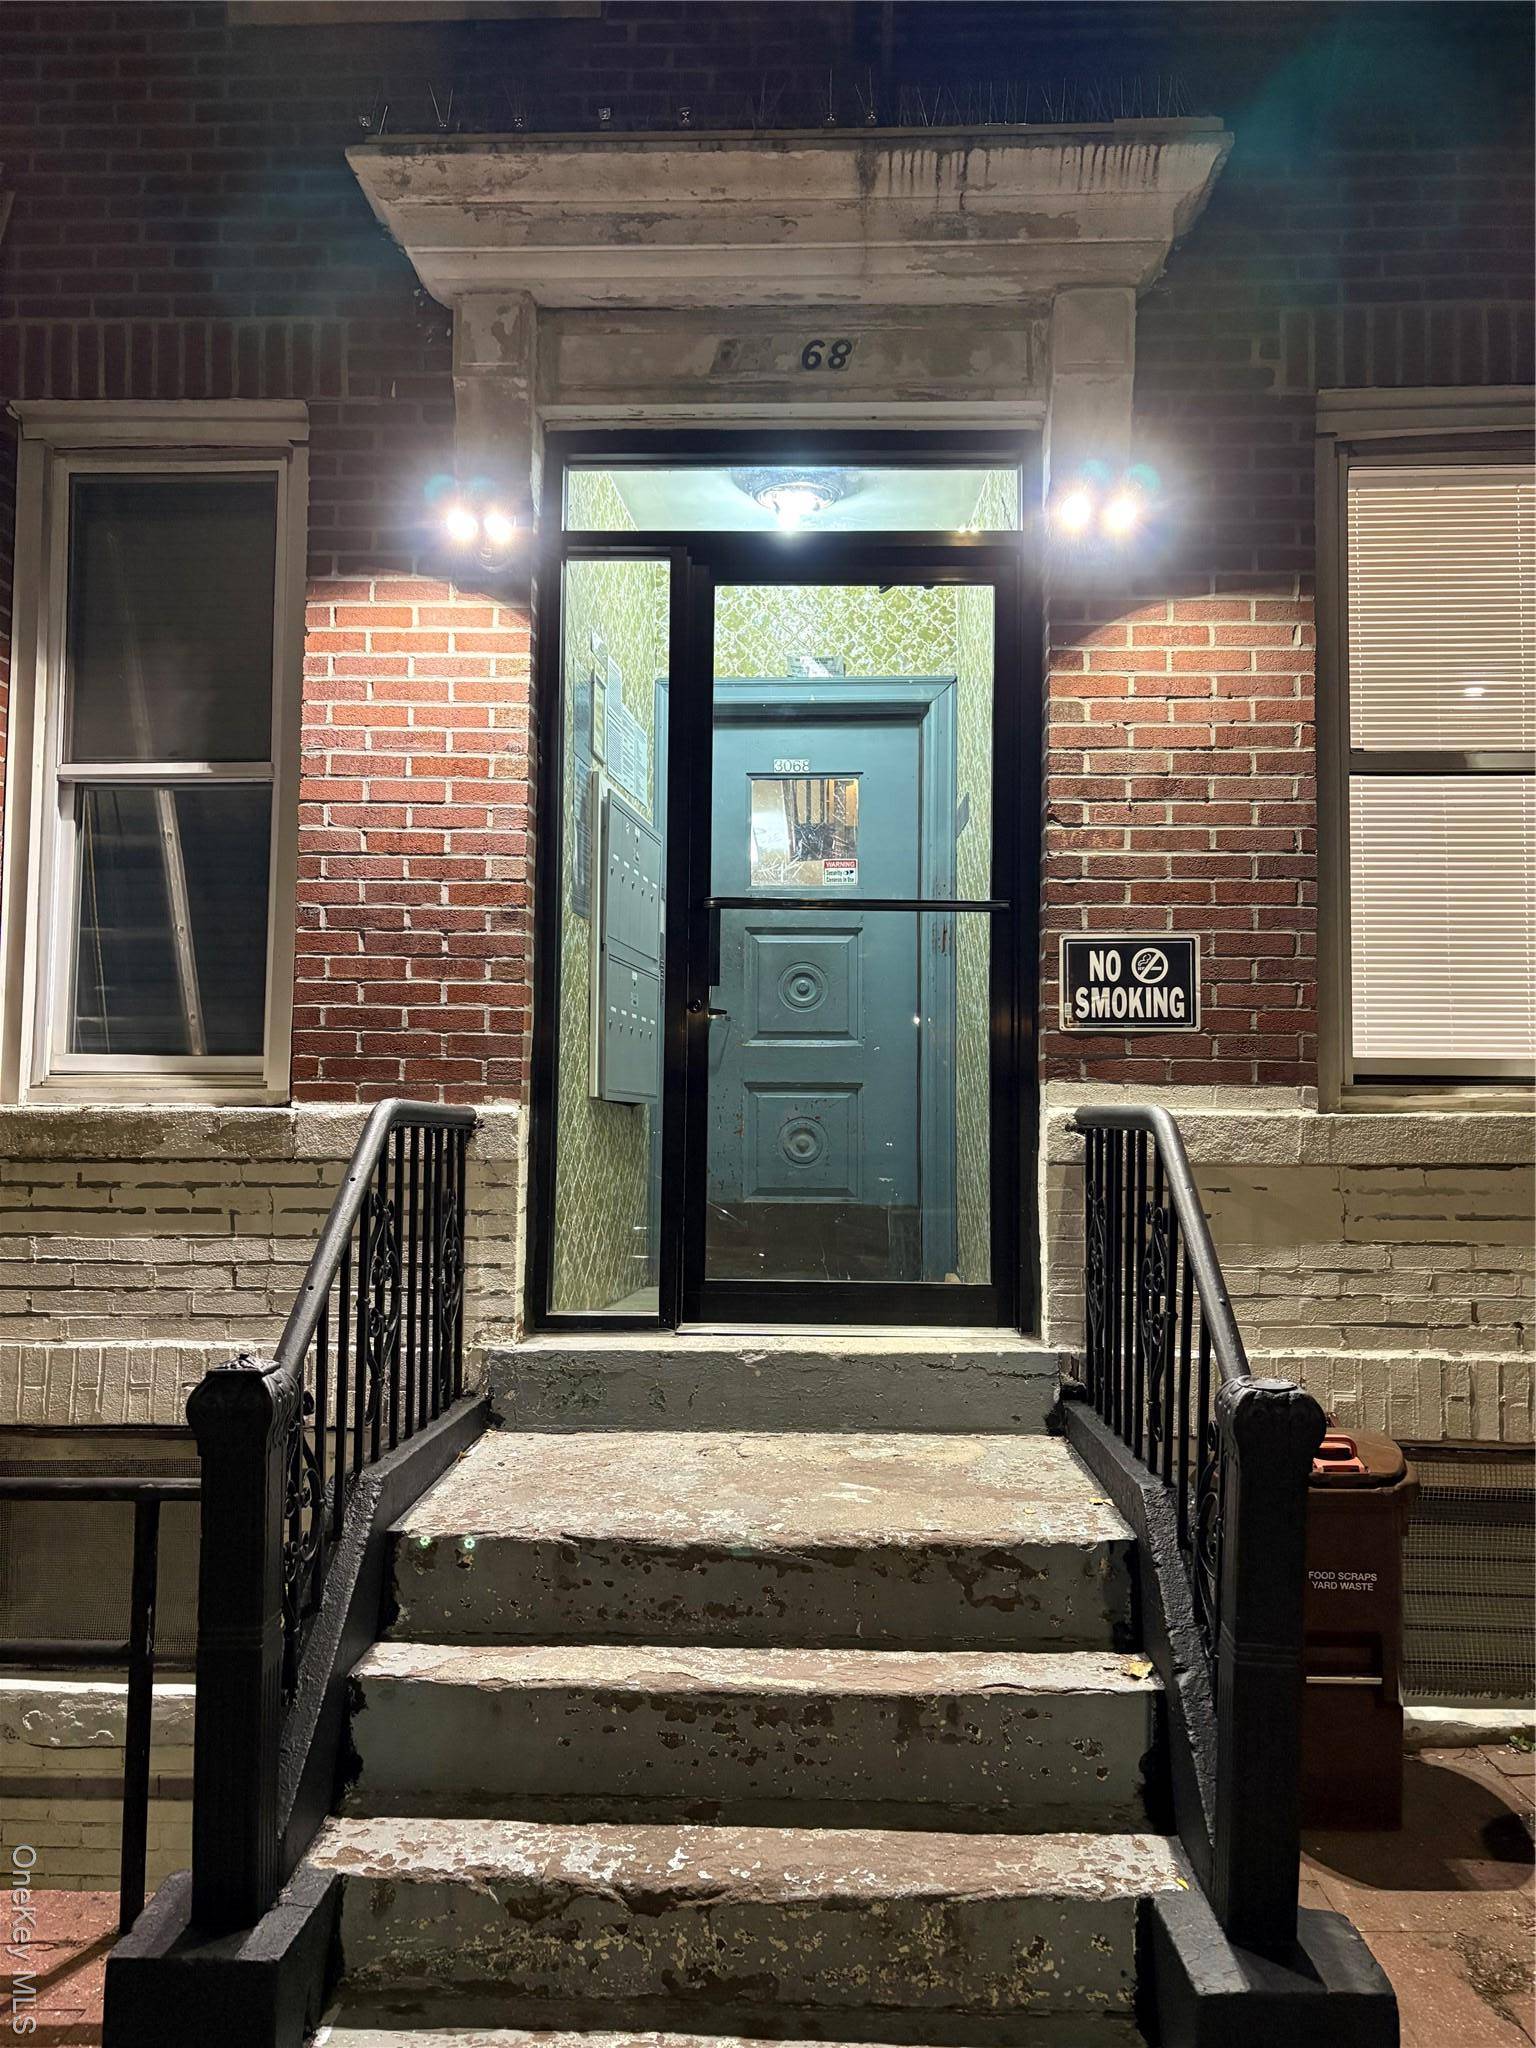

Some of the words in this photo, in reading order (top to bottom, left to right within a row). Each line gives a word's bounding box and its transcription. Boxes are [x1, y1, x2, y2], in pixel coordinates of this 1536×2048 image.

[802, 339, 852, 370] 68
[774, 760, 809, 771] 3068
[1089, 950, 1121, 982] NO
[1075, 987, 1185, 1018] SMOKING
[1308, 1571, 1335, 1579] FOOD
[1338, 1572, 1377, 1581] SCRAPS
[1312, 1581, 1337, 1590] YARD
[1340, 1582, 1374, 1591] WASTE
